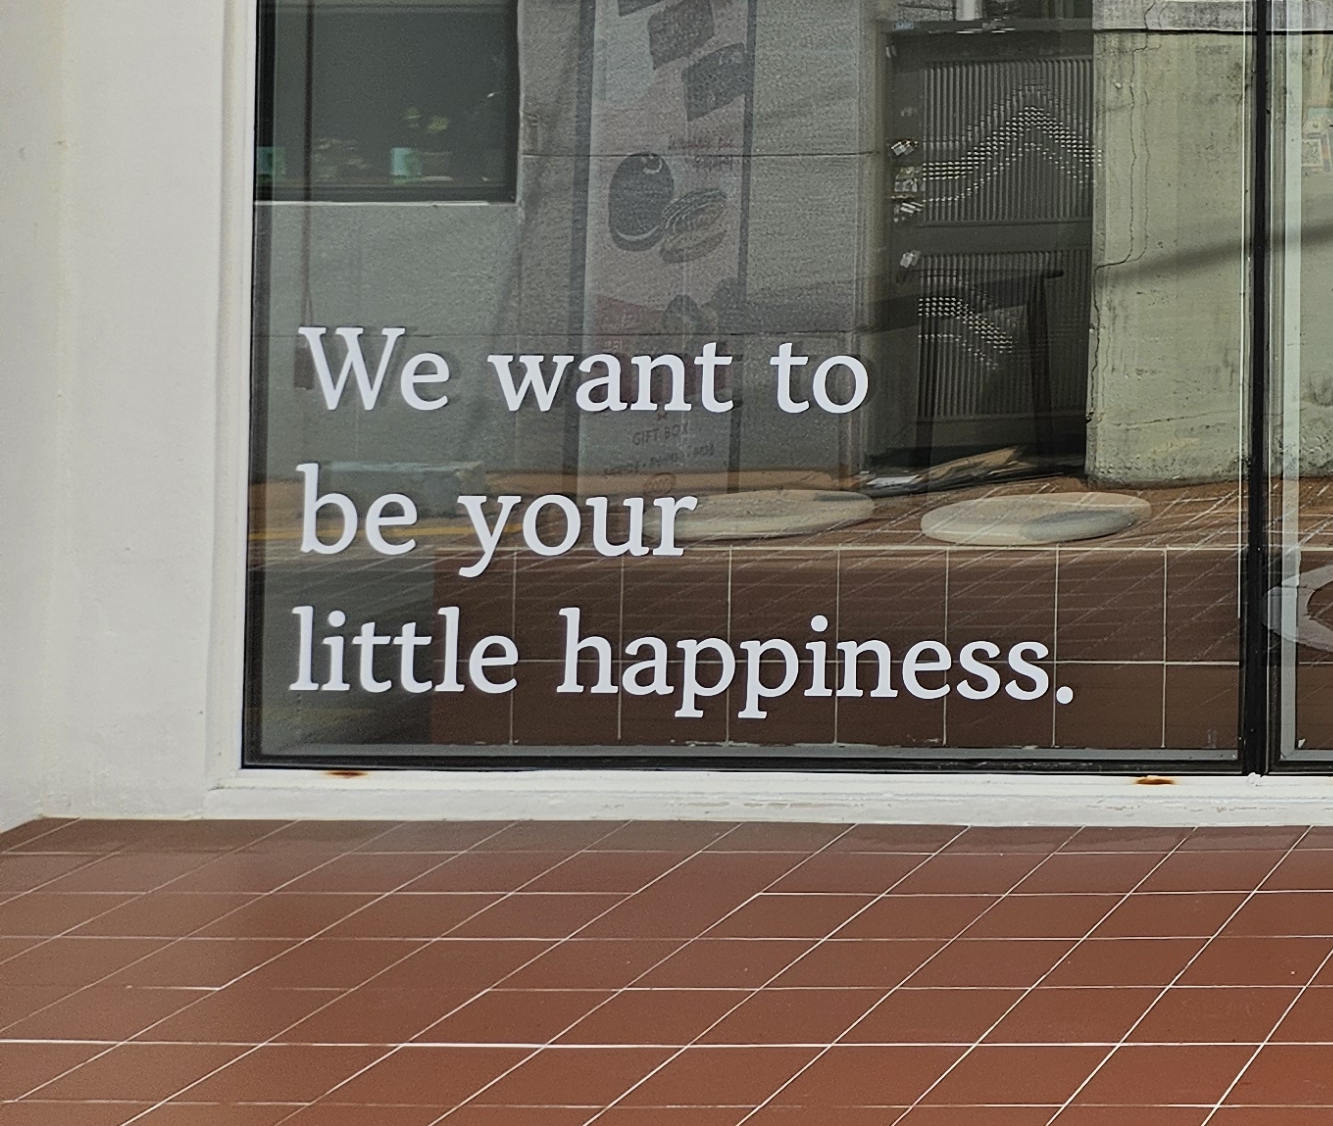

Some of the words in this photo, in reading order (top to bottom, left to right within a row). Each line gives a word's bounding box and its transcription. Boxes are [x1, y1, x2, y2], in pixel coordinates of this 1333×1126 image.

[298, 326, 450, 412] We
[488, 342, 733, 414] want
[771, 342, 869, 415] to
[296, 463, 418, 556] be
[457, 492, 699, 578] your
[289, 606, 518, 694] little
[557, 606, 1076, 719] happiness.
